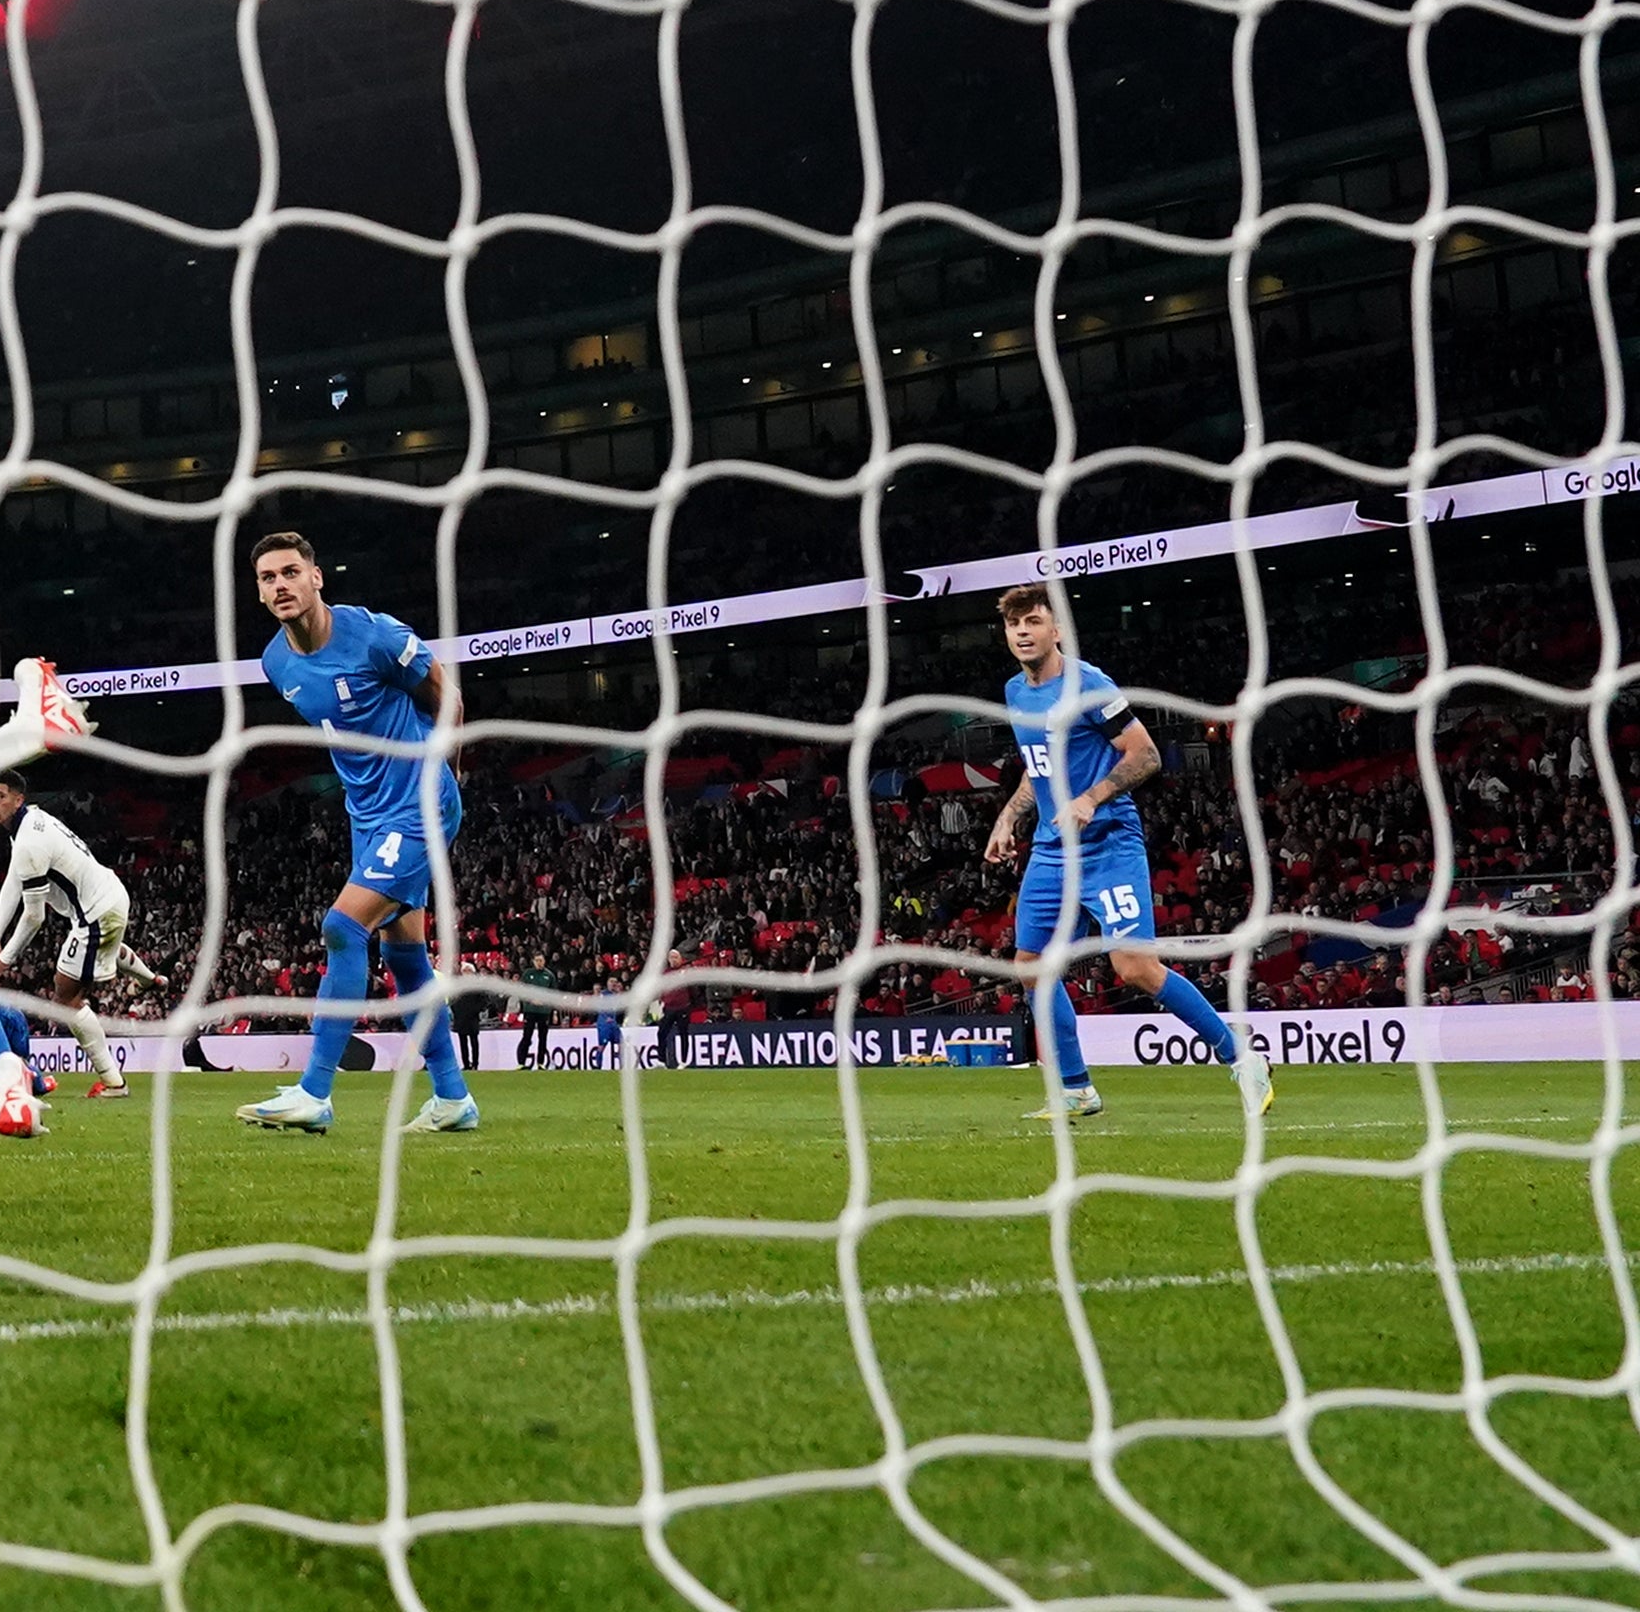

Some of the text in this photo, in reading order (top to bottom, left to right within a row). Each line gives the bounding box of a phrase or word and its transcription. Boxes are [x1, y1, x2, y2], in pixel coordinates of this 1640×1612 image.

[1036, 537, 1167, 576] Google Pixel 9
[671, 609, 707, 629] Pixel
[711, 605, 720, 623] 9
[469, 626, 571, 657] Google Pixel 9
[65, 670, 180, 696] Google Pixel 9
[1021, 745, 1052, 778] 15
[376, 831, 403, 867] 4
[1099, 885, 1140, 925] 15
[67, 937, 79, 958] 8
[29, 1045, 71, 1072] oogle
[674, 1034, 744, 1067] UEFA
[751, 1031, 880, 1066] NATIONS
[1134, 1020, 1406, 1065] Gooe Pixel 9
